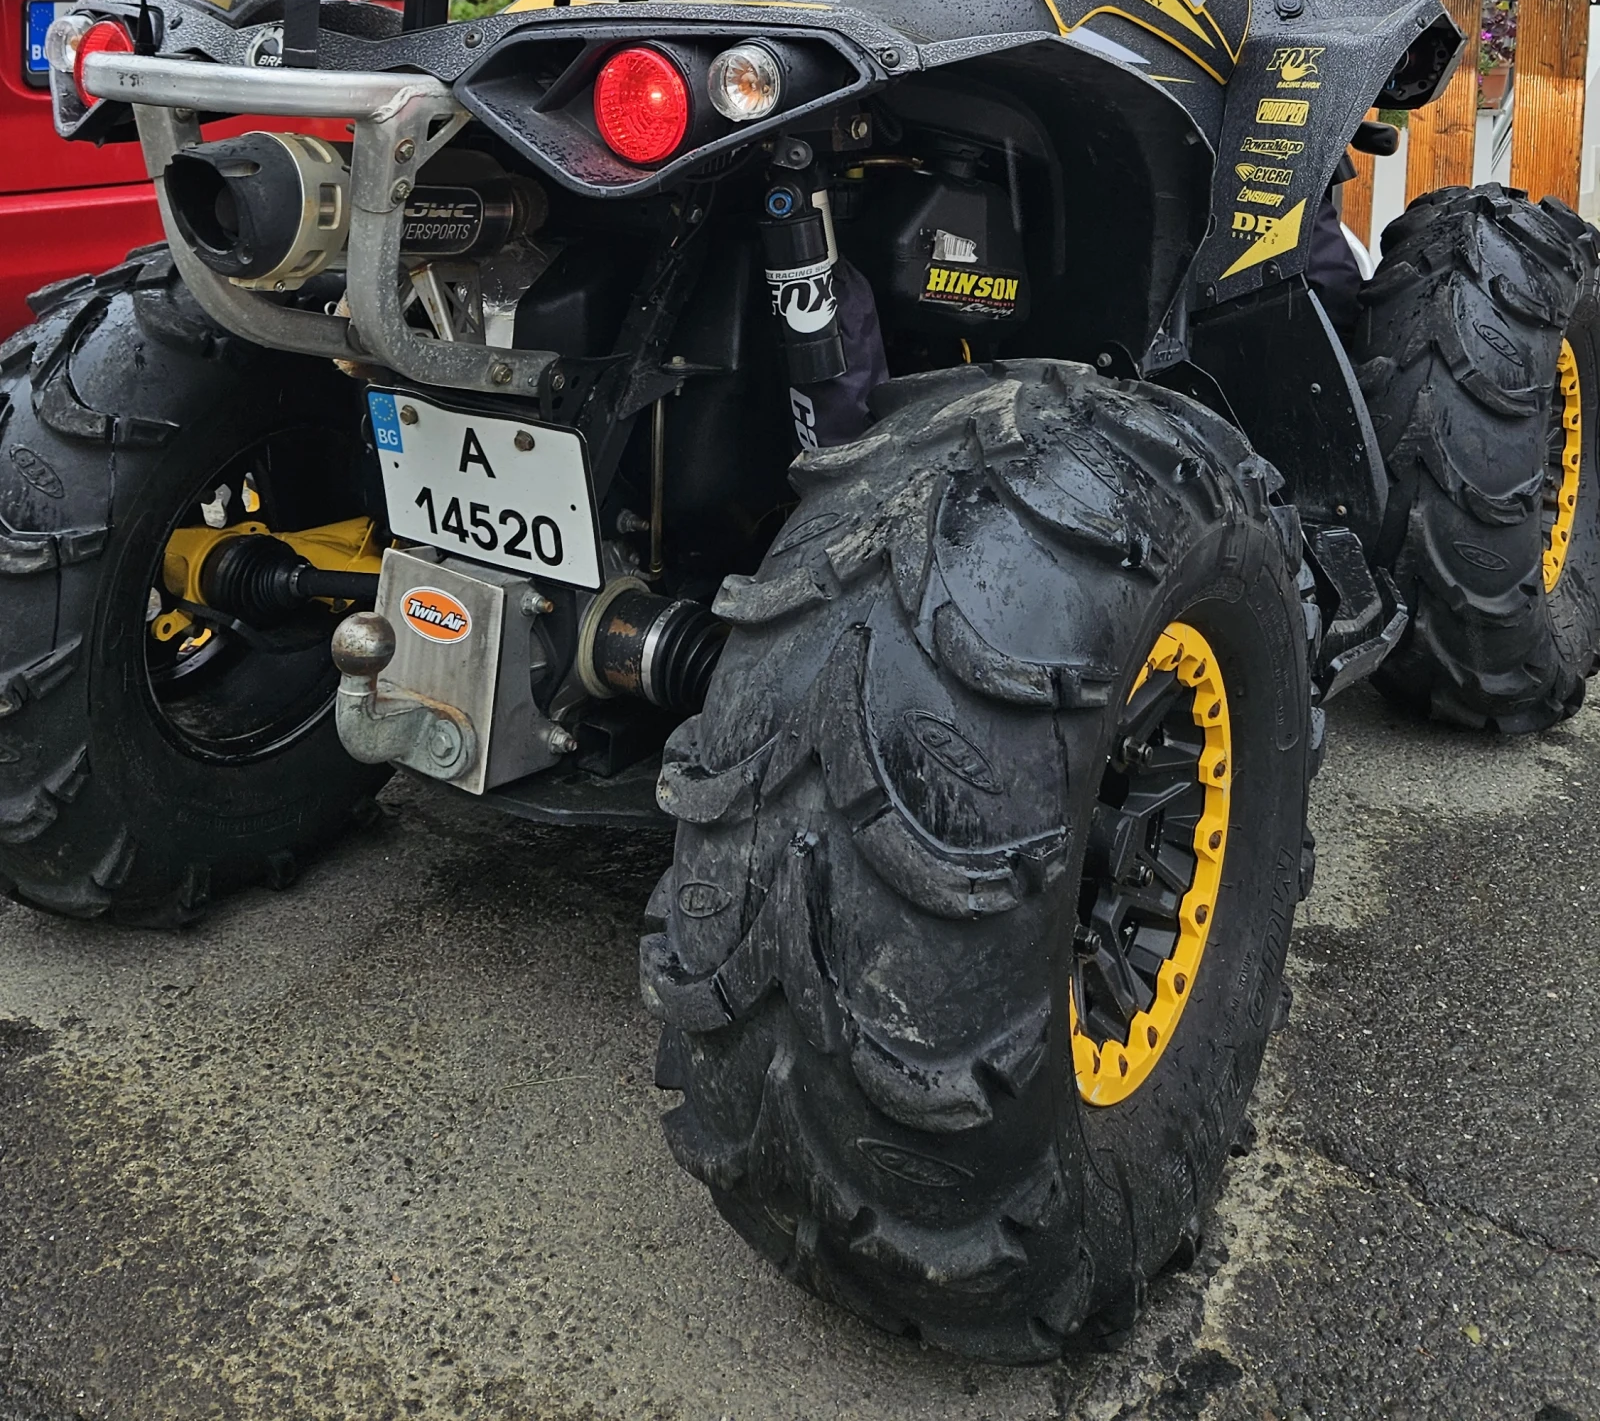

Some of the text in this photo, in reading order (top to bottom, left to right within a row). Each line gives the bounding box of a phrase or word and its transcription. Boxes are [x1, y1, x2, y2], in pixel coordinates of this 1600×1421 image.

[31, 44, 49, 60] B
[1265, 47, 1326, 75] FOX
[1253, 166, 1293, 185] CYCRA
[775, 268, 813, 279] RACING
[926, 267, 1019, 300] HINSON
[767, 270, 838, 324] FOX
[377, 428, 399, 446] BG
[459, 427, 496, 479] A
[415, 486, 564, 567] 14520
[407, 598, 468, 633] Twin Air
